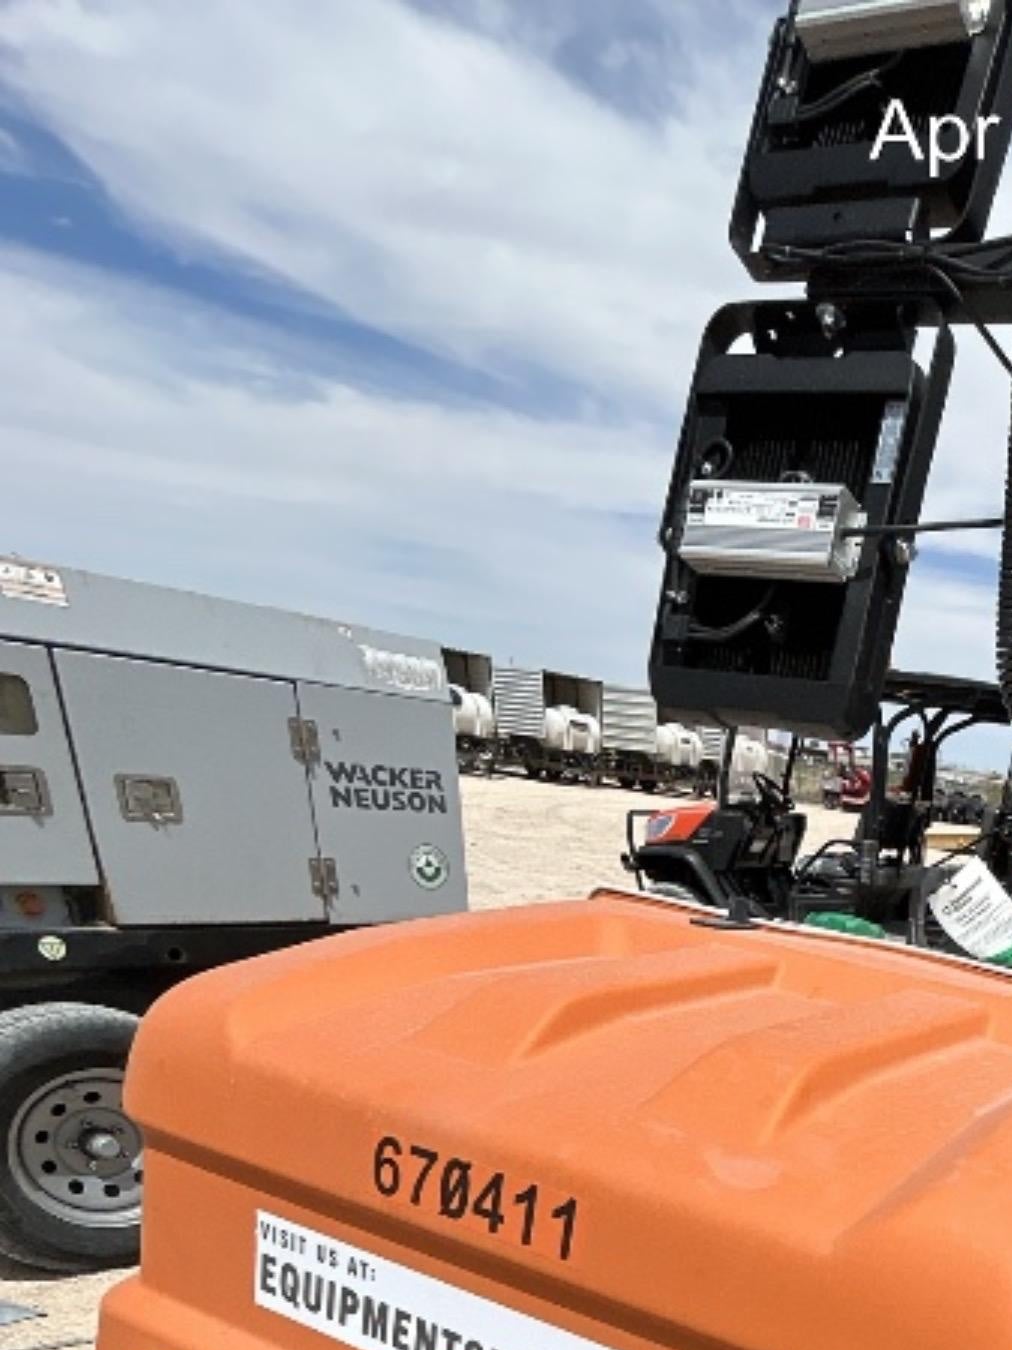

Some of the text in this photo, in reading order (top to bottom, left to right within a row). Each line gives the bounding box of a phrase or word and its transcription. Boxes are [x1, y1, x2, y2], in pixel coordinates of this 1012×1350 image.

[324, 761, 444, 792] WACKER
[329, 785, 447, 814] NEUSON
[373, 1136, 578, 1260] 670411
[260, 1220, 376, 1282] VISIT US AT:
